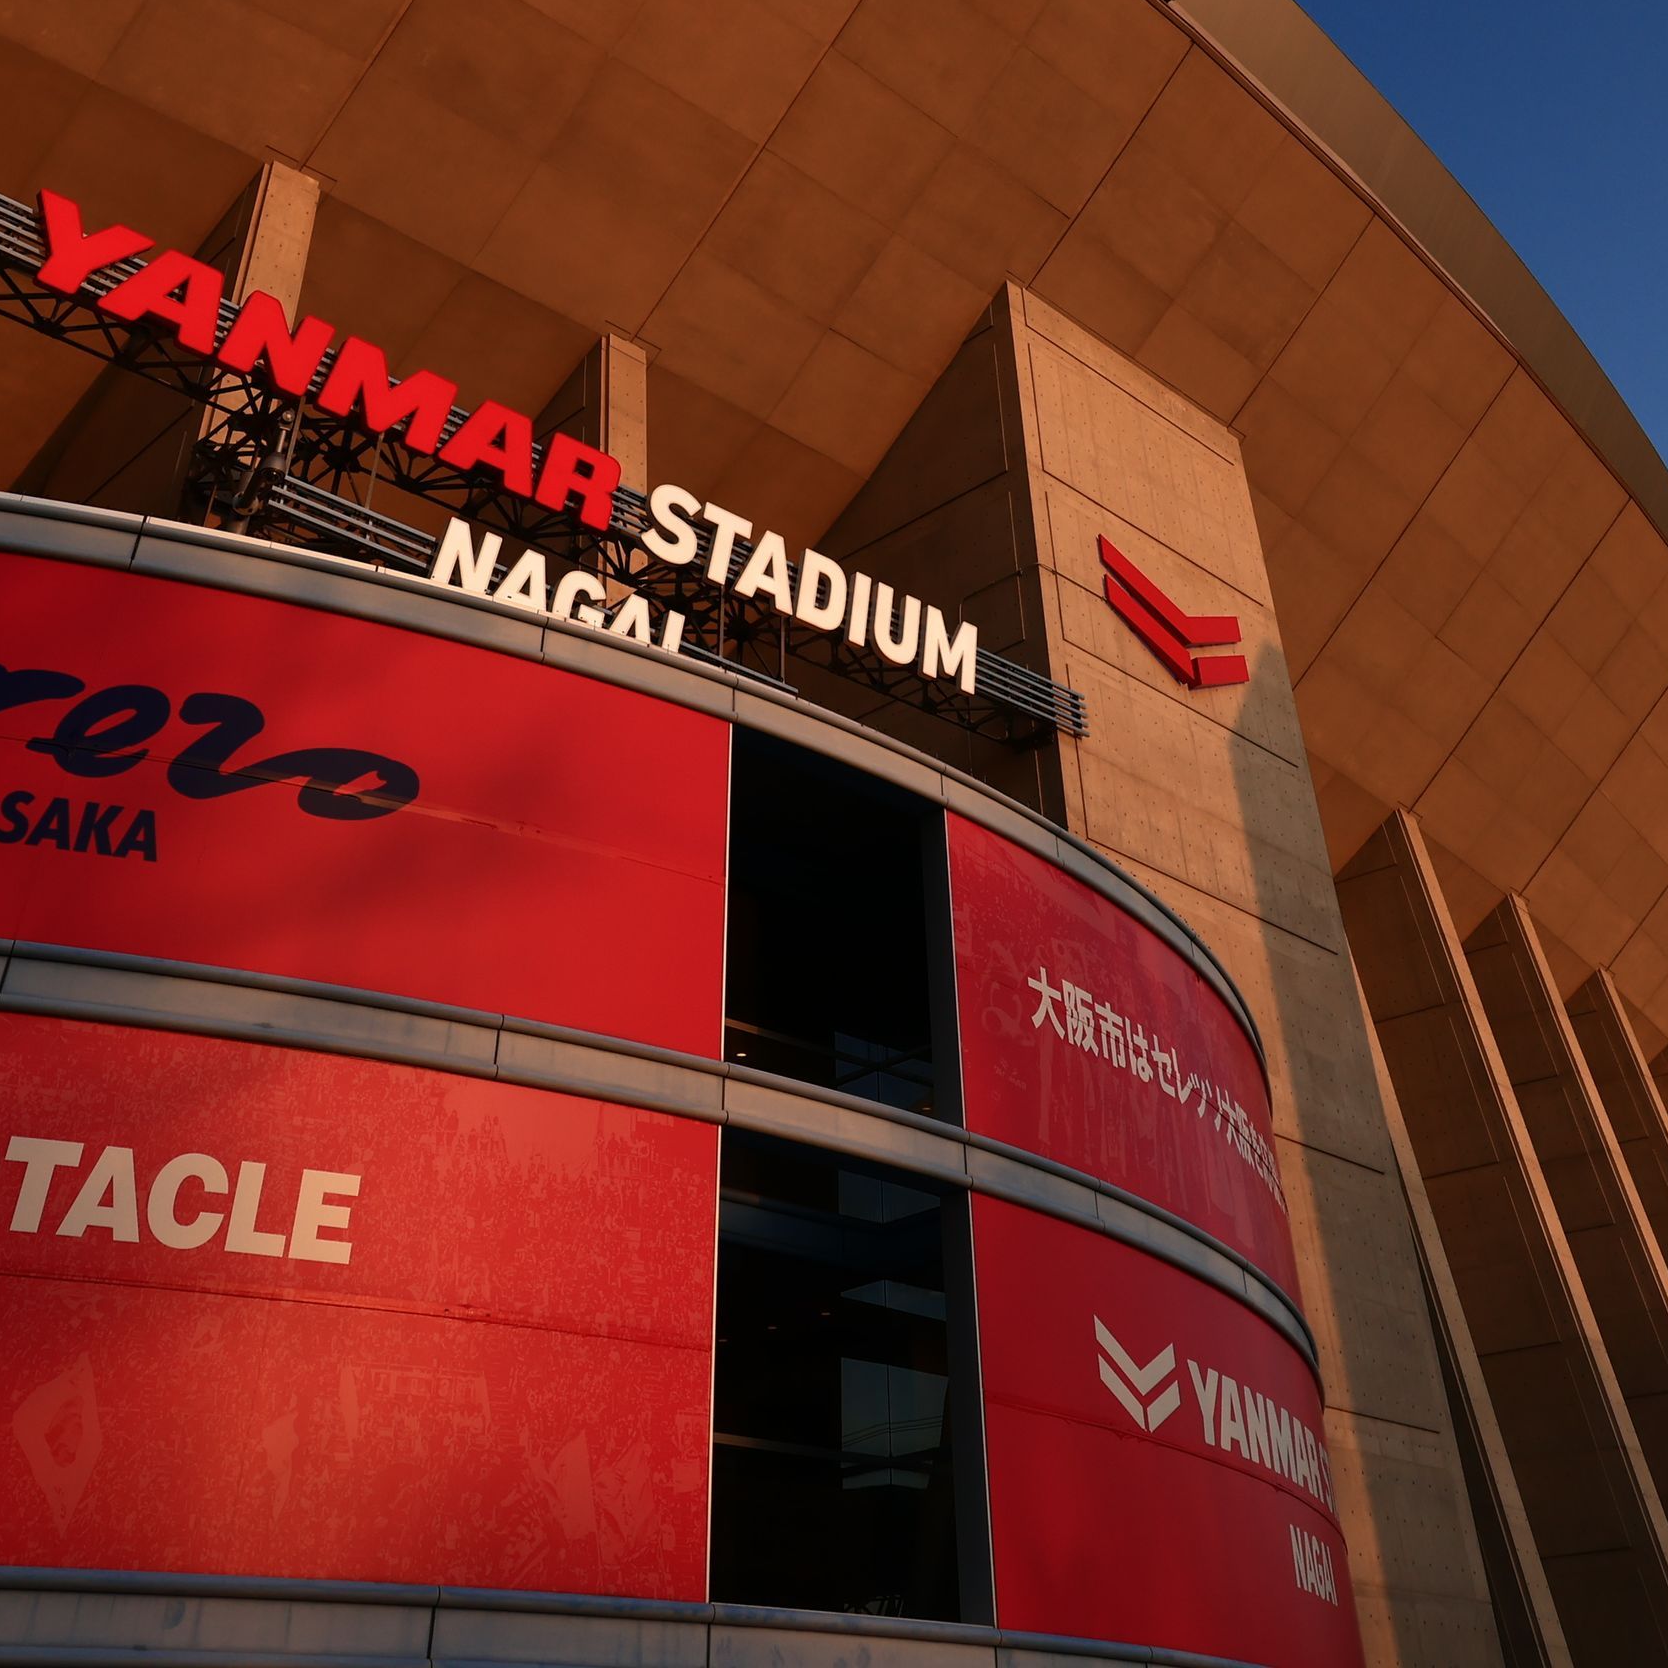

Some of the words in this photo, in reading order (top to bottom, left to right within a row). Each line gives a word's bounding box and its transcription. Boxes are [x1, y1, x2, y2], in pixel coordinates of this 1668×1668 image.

[34, 189, 622, 532] YANMAR
[640, 483, 980, 696] STADIUM
[430, 516, 686, 653] NAGAI
[1187, 1358, 1324, 1504] YANMAR
[1289, 1523, 1338, 1606] NAGAI
